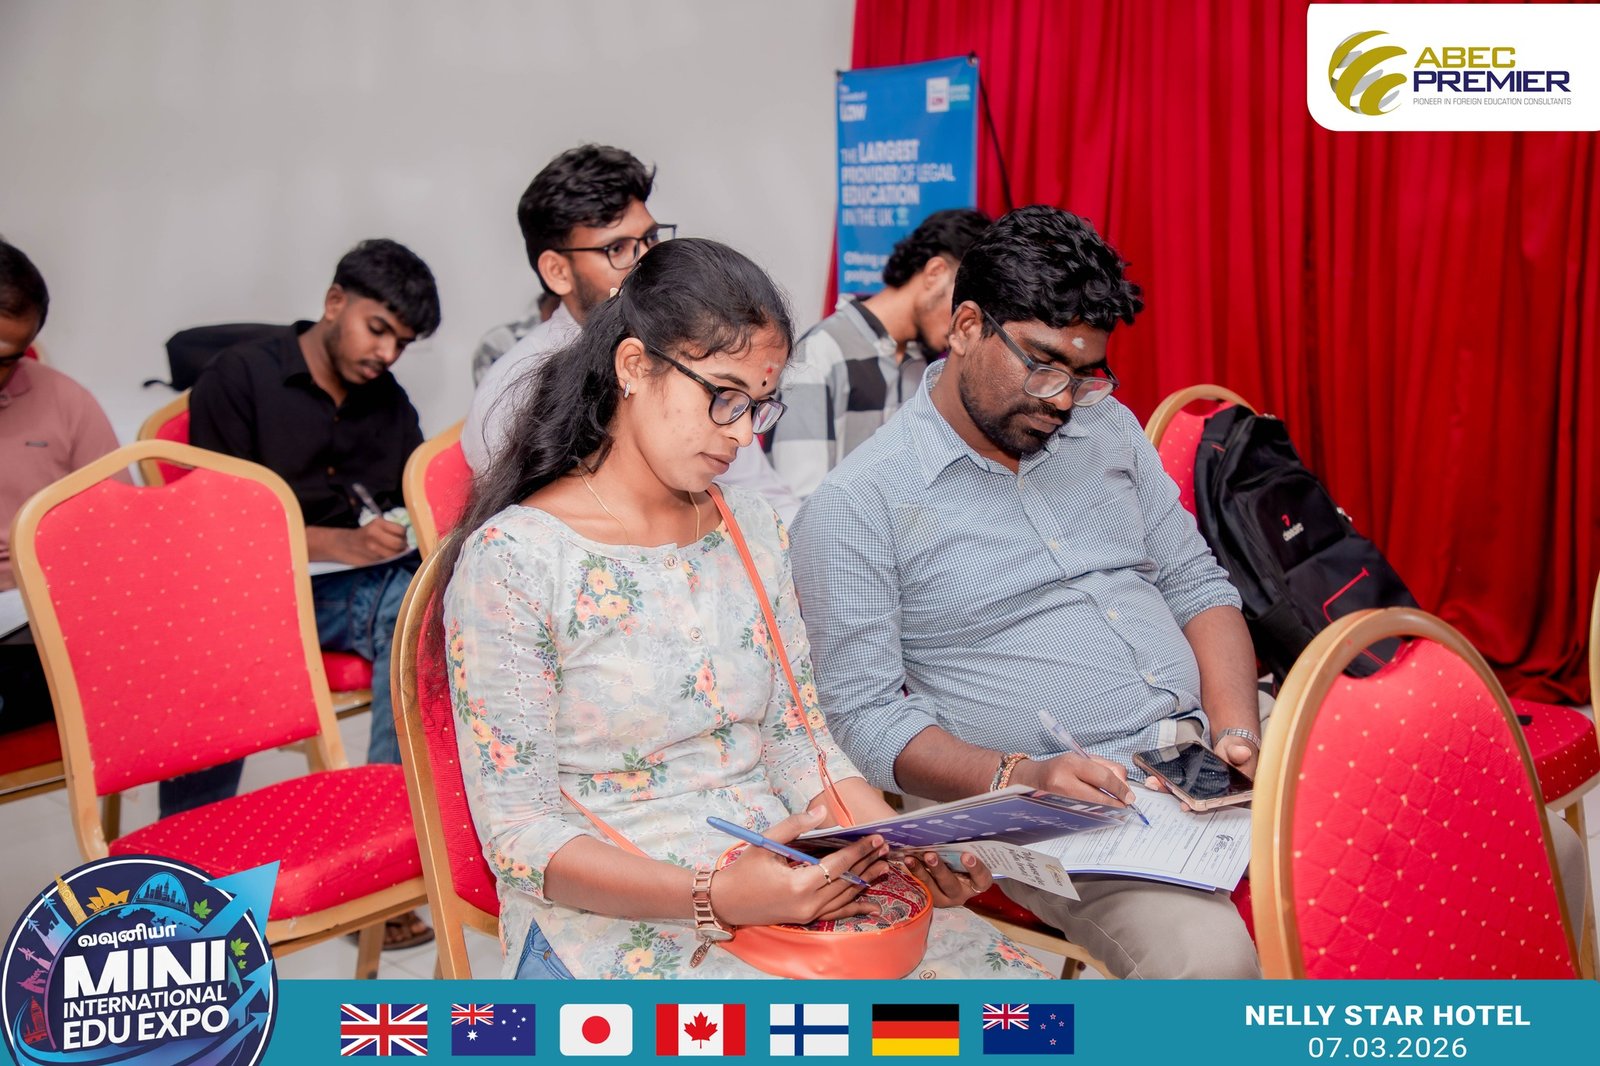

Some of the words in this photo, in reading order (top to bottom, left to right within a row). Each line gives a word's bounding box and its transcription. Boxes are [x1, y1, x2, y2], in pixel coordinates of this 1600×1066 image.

[841, 147, 858, 164] THE
[858, 139, 920, 163] LARGEST
[841, 165, 898, 184] PROVIDER
[899, 164, 915, 183] OF
[917, 163, 956, 182] LEGAL
[842, 184, 920, 206] EDUCATION
[842, 208, 856, 226] IN
[857, 208, 876, 226] THE
[877, 208, 895, 227] UK
